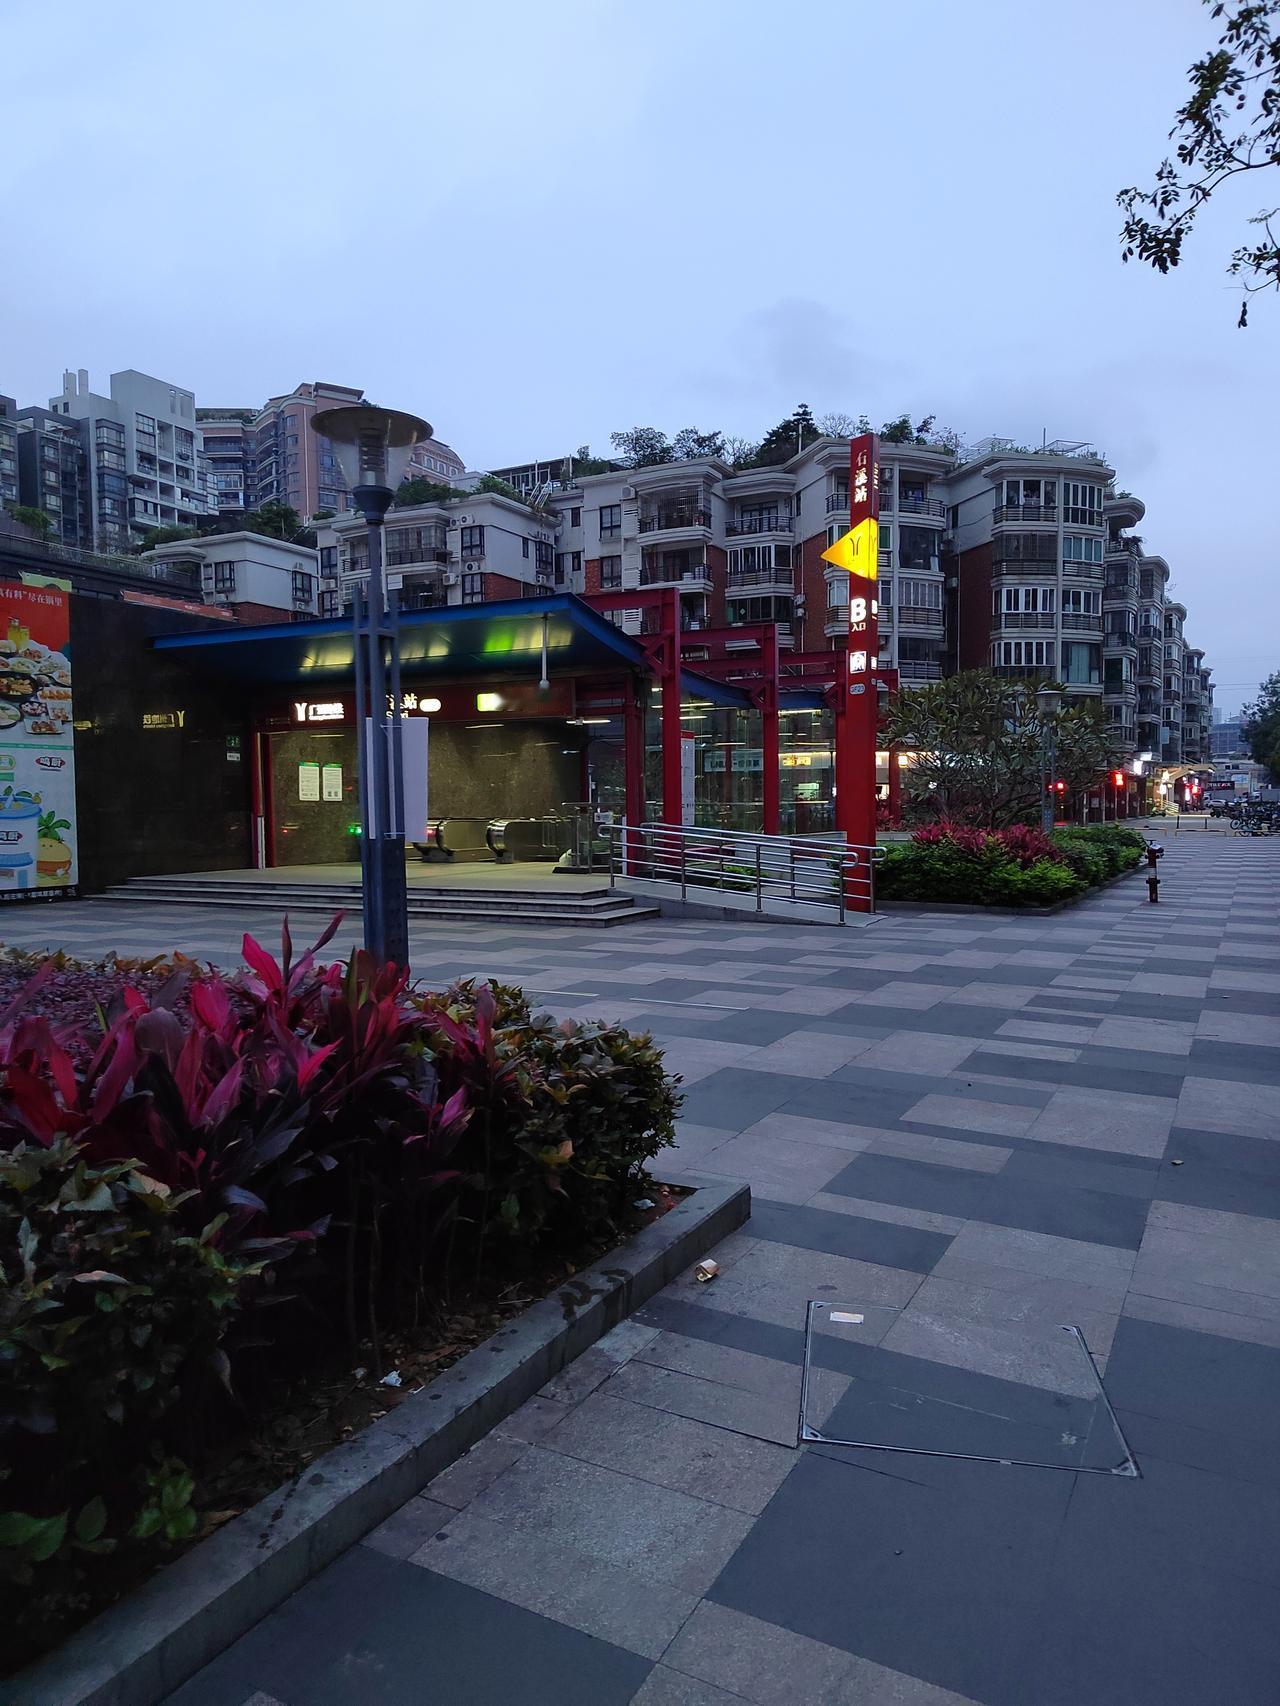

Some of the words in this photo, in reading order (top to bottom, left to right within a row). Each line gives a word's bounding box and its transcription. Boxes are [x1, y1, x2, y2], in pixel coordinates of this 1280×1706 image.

[855, 449, 868, 504] 石溪站
[850, 597, 867, 623] B
[851, 622, 867, 632] 入口
